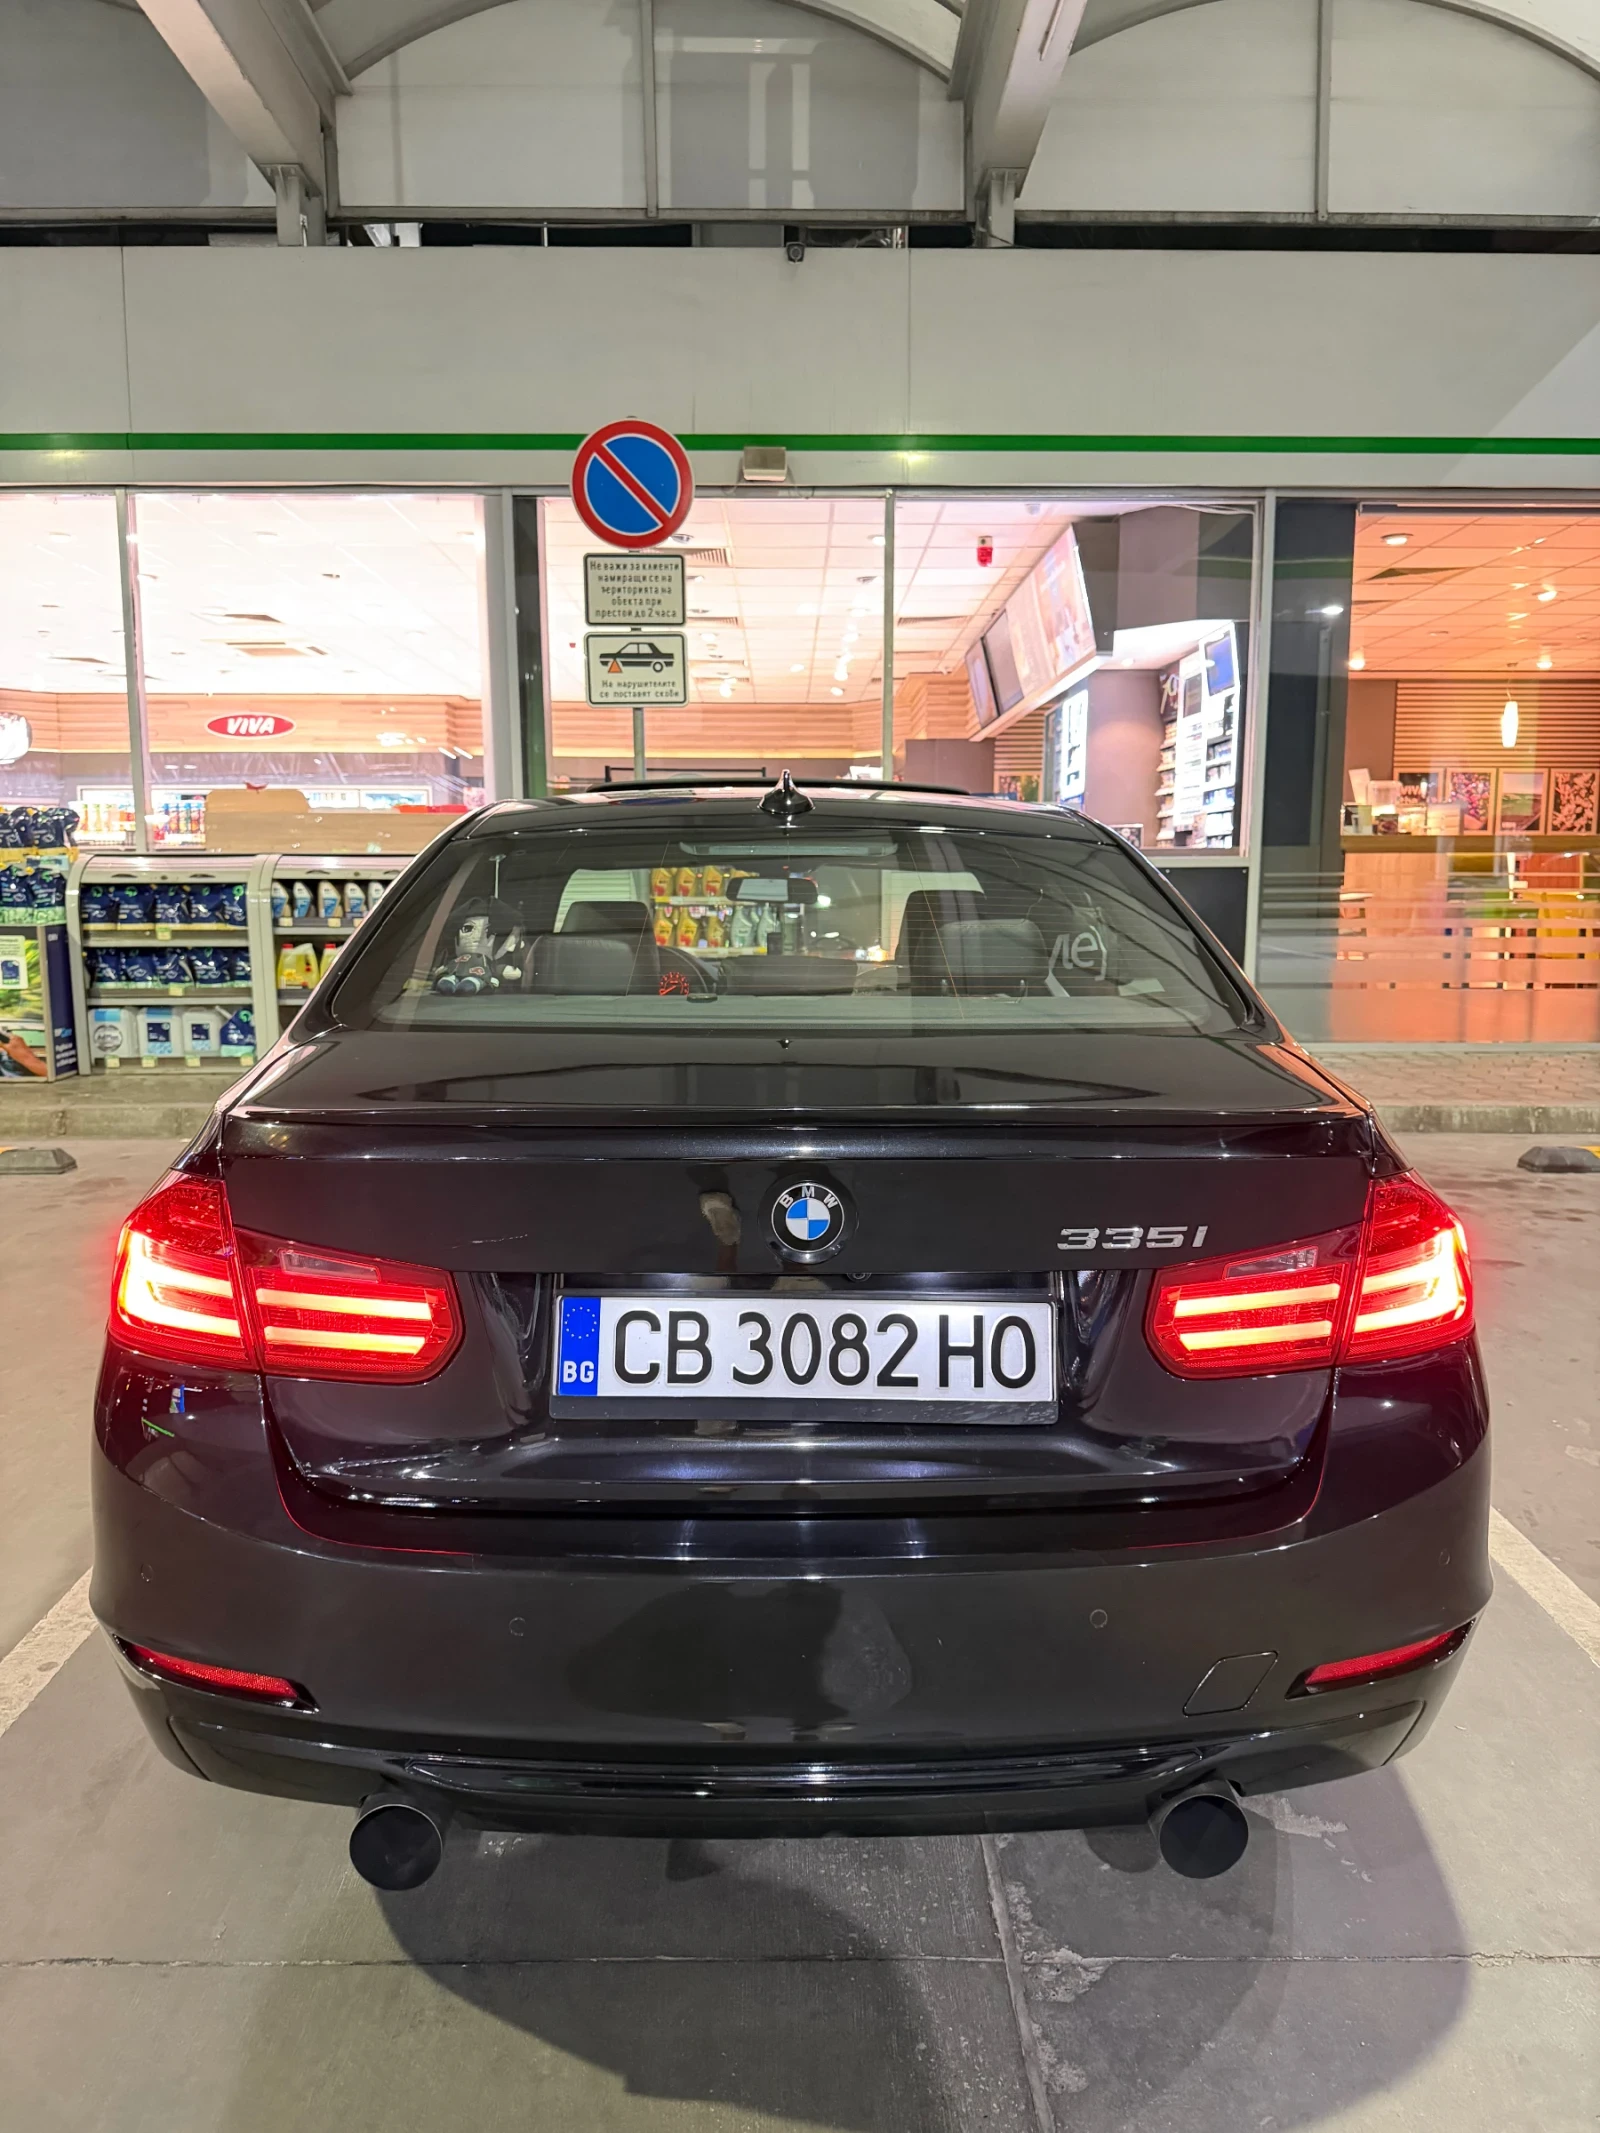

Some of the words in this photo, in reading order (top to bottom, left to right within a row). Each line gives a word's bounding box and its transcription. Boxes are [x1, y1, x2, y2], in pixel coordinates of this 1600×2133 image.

[590, 561, 602, 571] Не
[603, 563, 628, 571] важи
[630, 563, 640, 571] за
[642, 563, 679, 571] клиенти
[598, 575, 647, 584] намиращи
[649, 575, 659, 583] се
[661, 575, 673, 583] на
[661, 587, 672, 595] на
[611, 596, 643, 606] обекта
[645, 598, 662, 607] при
[595, 609, 632, 619] престой
[634, 610, 646, 618] до
[647, 608, 654, 618] 2
[655, 610, 677, 618] часа
[602, 680, 613, 688] На
[617, 681, 676, 690] нарушителите
[613, 691, 652, 699] поставят
[655, 689, 680, 698] скоби
[226, 716, 276, 735] VIVA
[779, 1186, 839, 1209] BMW
[614, 1309, 713, 1385] CB
[732, 1311, 920, 1388] 3082
[938, 1313, 1037, 1389] HO
[562, 1360, 596, 1384] BG
